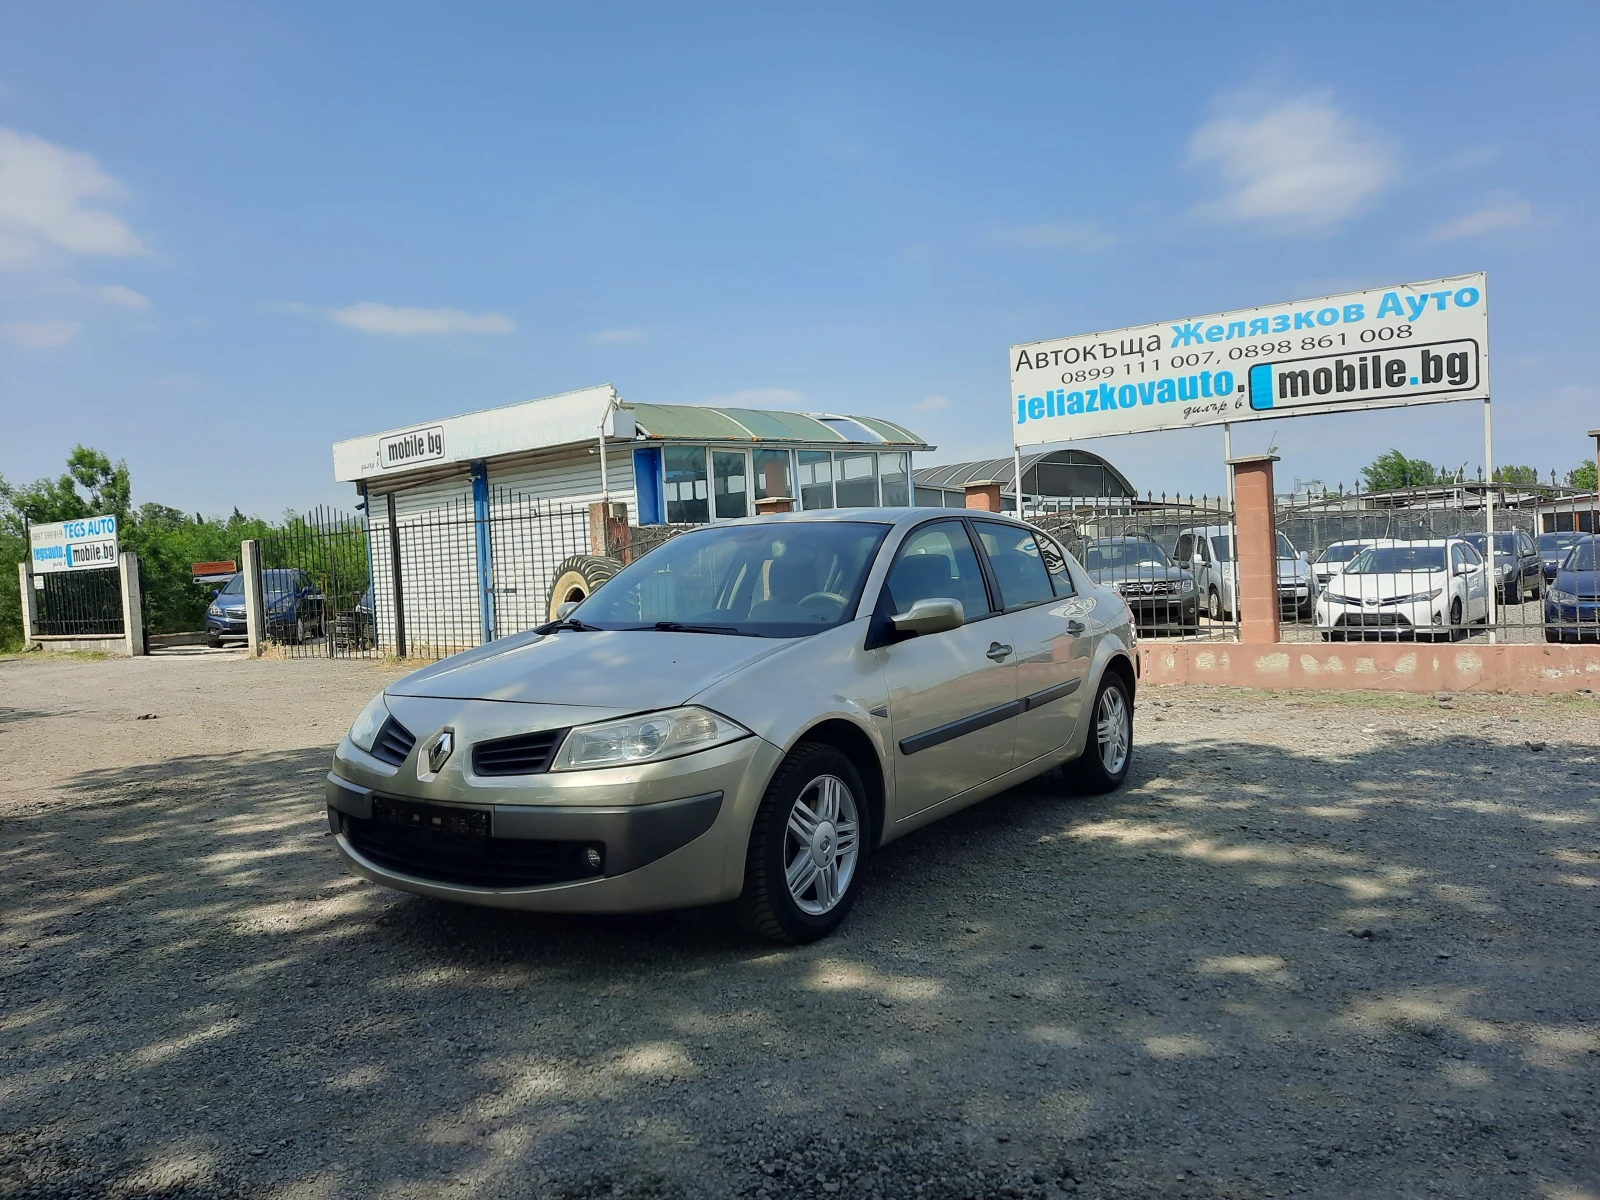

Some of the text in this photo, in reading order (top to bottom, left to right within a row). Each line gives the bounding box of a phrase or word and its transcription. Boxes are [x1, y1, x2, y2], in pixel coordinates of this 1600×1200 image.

[1015, 286, 1480, 372] Автокъща Желязков Ауто
[1061, 324, 1413, 384] 0899 111 007, 0898 861 008
[1278, 349, 1469, 399] mobile.bg
[1183, 402, 1228, 419] дилър
[64, 517, 115, 539] TEGS AUTO
[72, 542, 114, 563] mobile.bg
